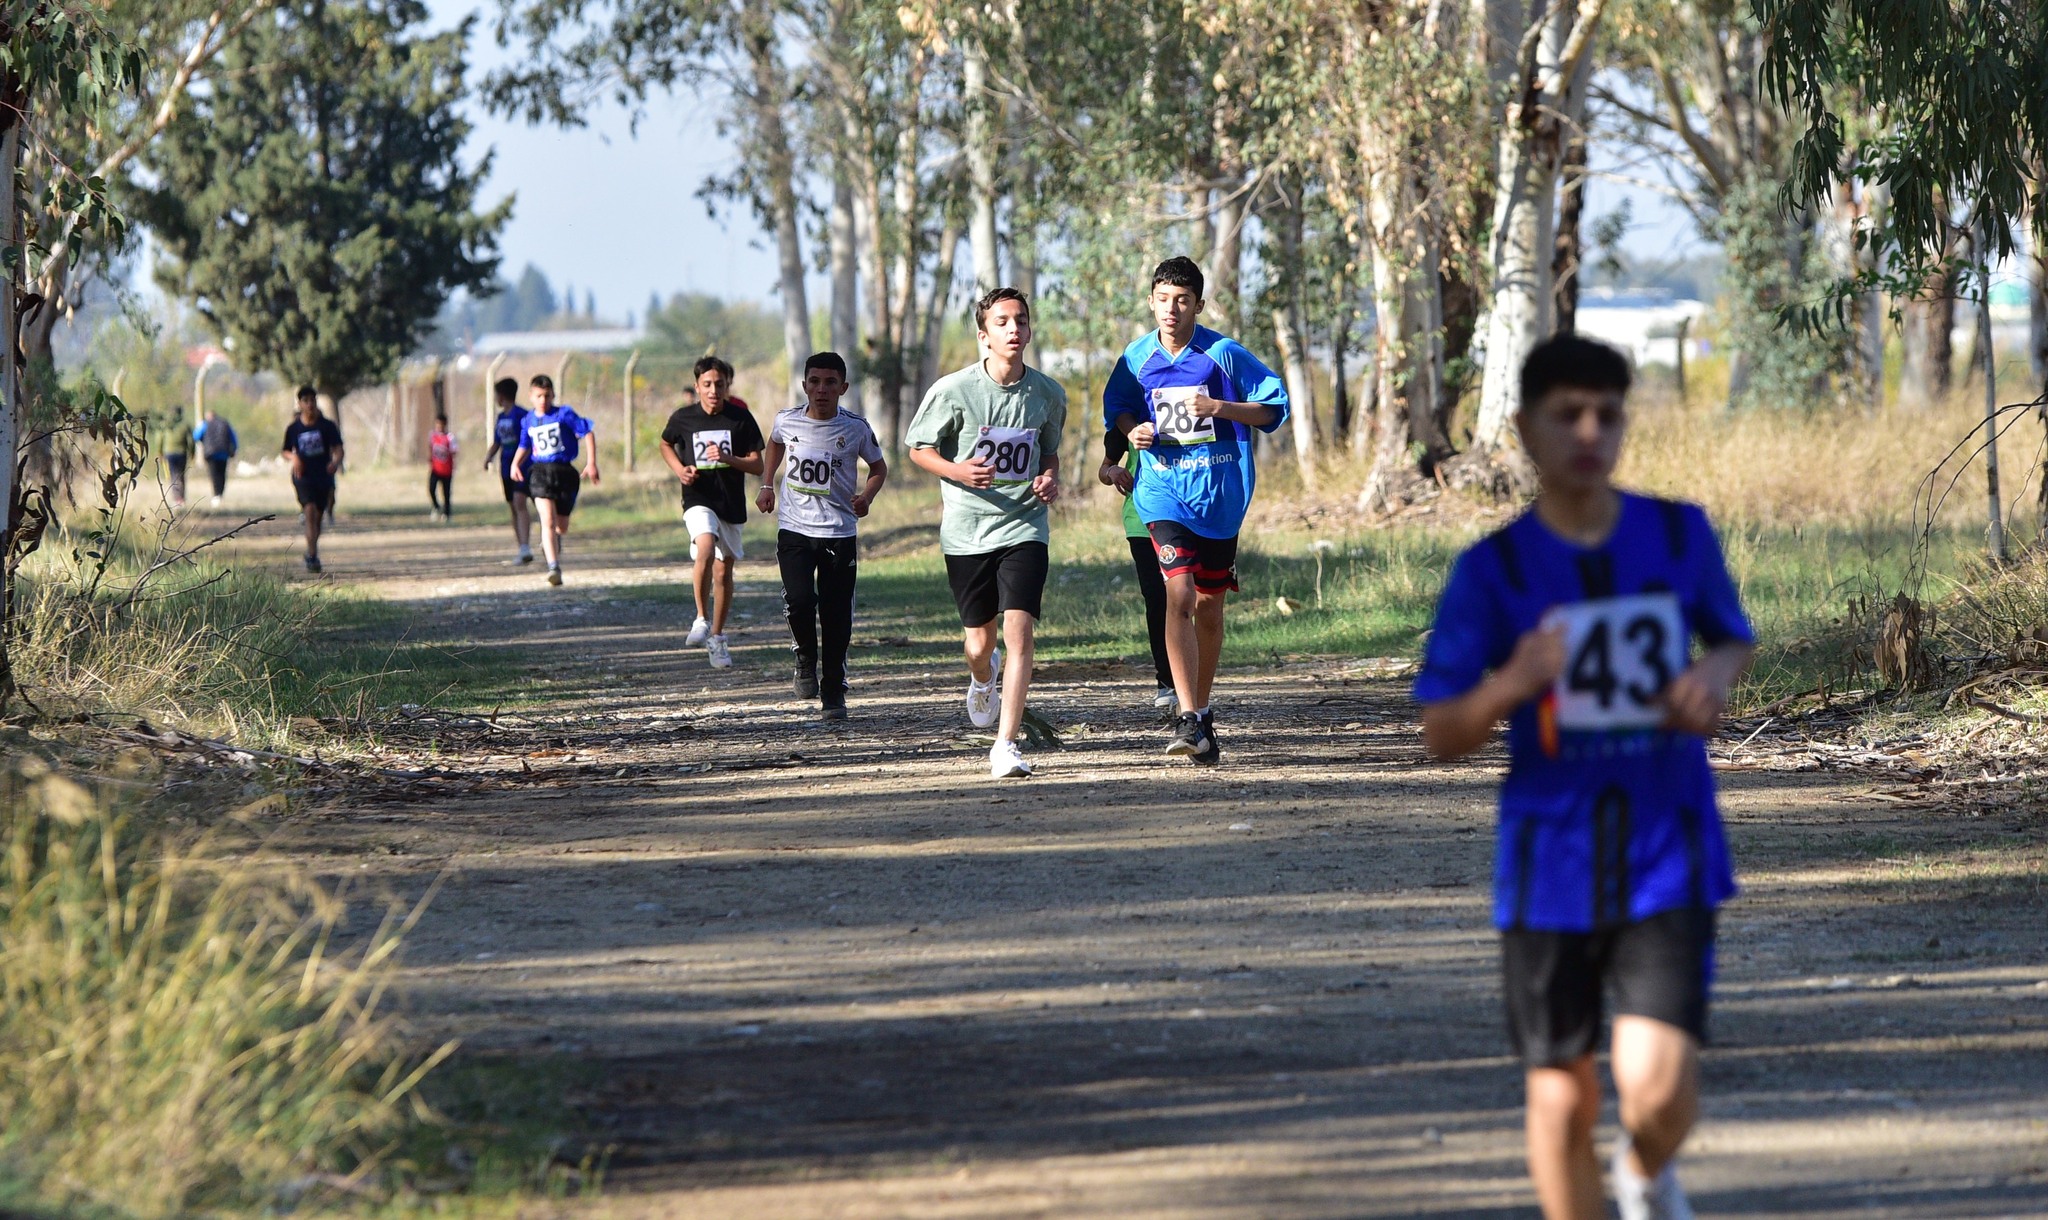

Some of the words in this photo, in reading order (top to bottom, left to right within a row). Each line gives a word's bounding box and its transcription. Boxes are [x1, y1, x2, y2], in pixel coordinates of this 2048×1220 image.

[537, 428, 559, 451] 55
[695, 440, 731, 461] 26
[787, 455, 830, 485] 260
[977, 439, 1031, 475] 280
[1569, 615, 1670, 708] 43
